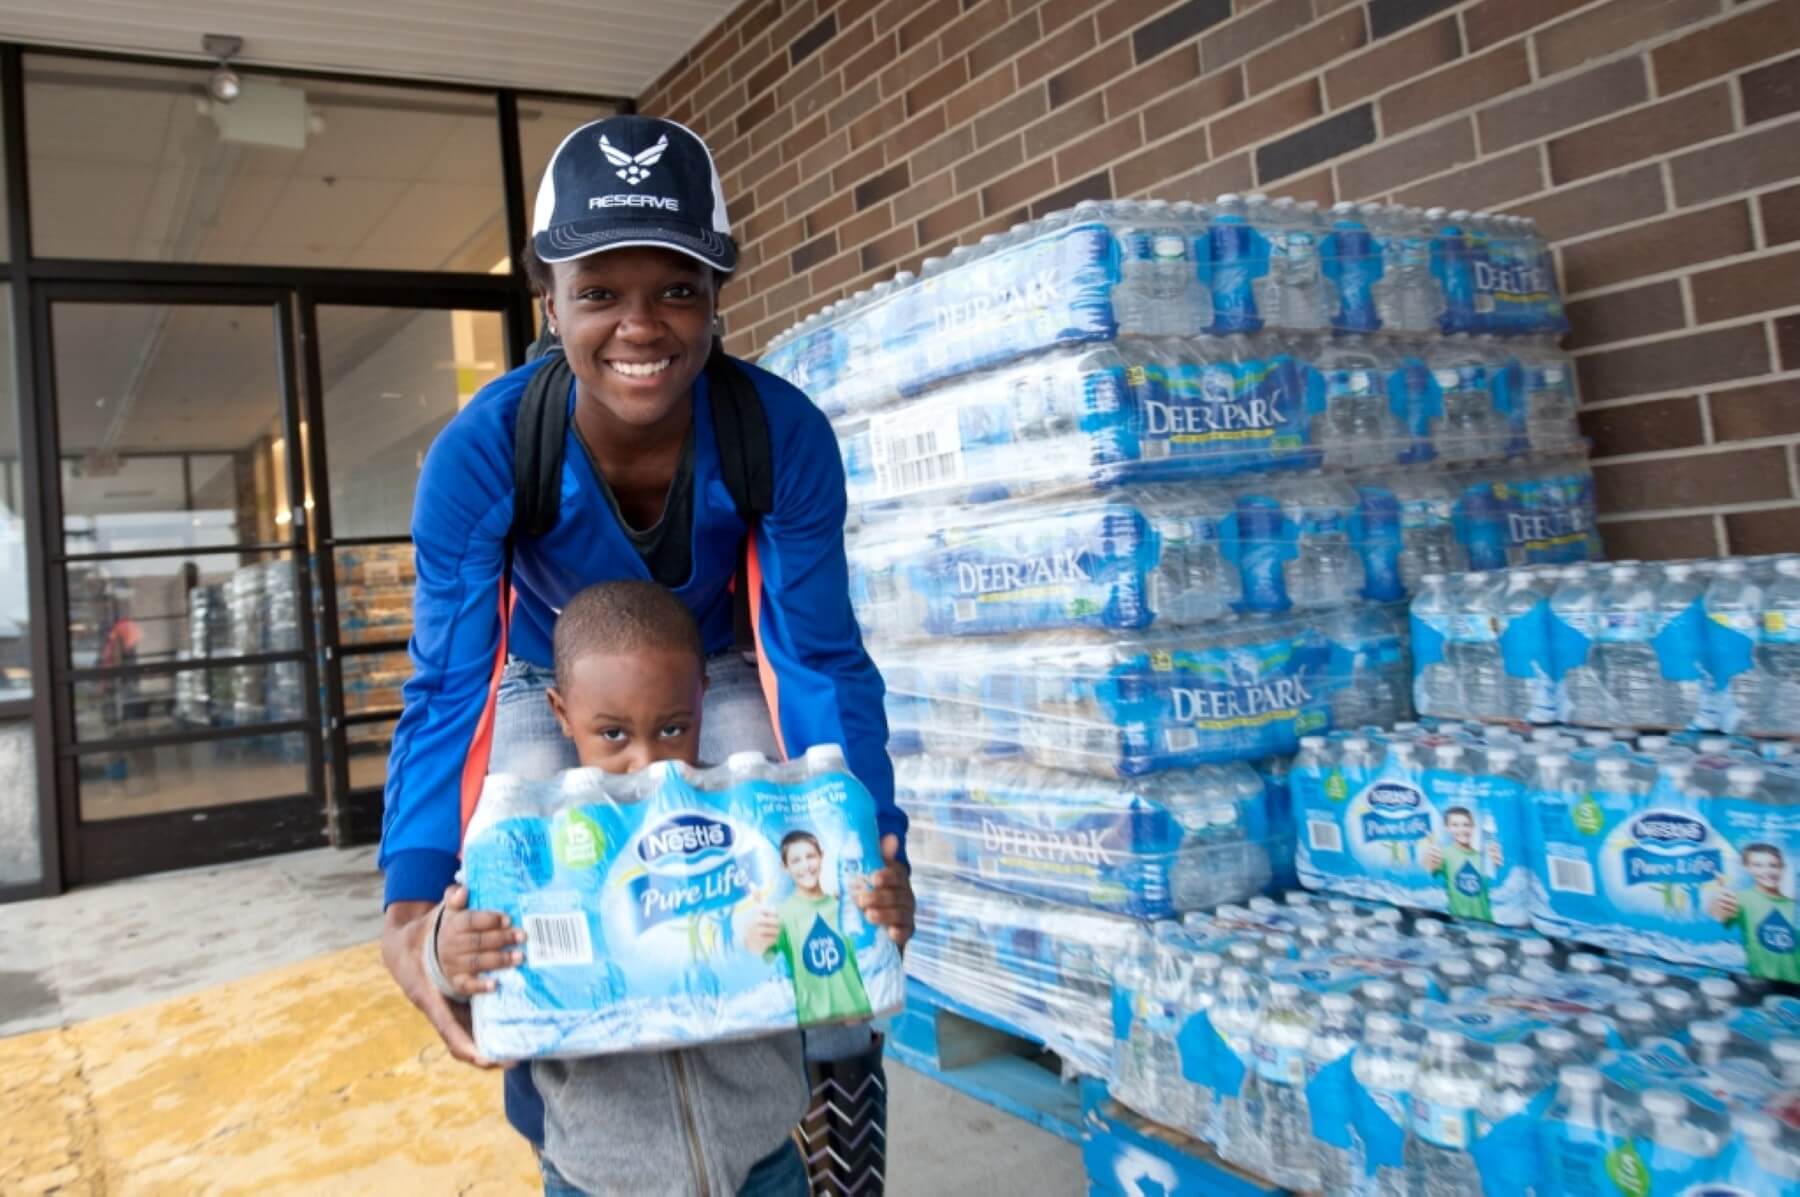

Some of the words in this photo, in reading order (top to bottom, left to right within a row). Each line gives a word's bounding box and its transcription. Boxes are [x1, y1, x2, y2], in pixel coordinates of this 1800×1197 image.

[589, 194, 679, 211] RESERVE
[1144, 399, 1222, 434] DEER
[1221, 388, 1288, 429] PARK
[958, 561, 1026, 593] DEER
[1170, 687, 1248, 722] DEER
[1247, 665, 1312, 714] PARK
[982, 817, 1044, 858] DEER
[1046, 829, 1115, 866] PARK
[640, 887, 702, 918] Pure
[705, 863, 749, 898] Life
